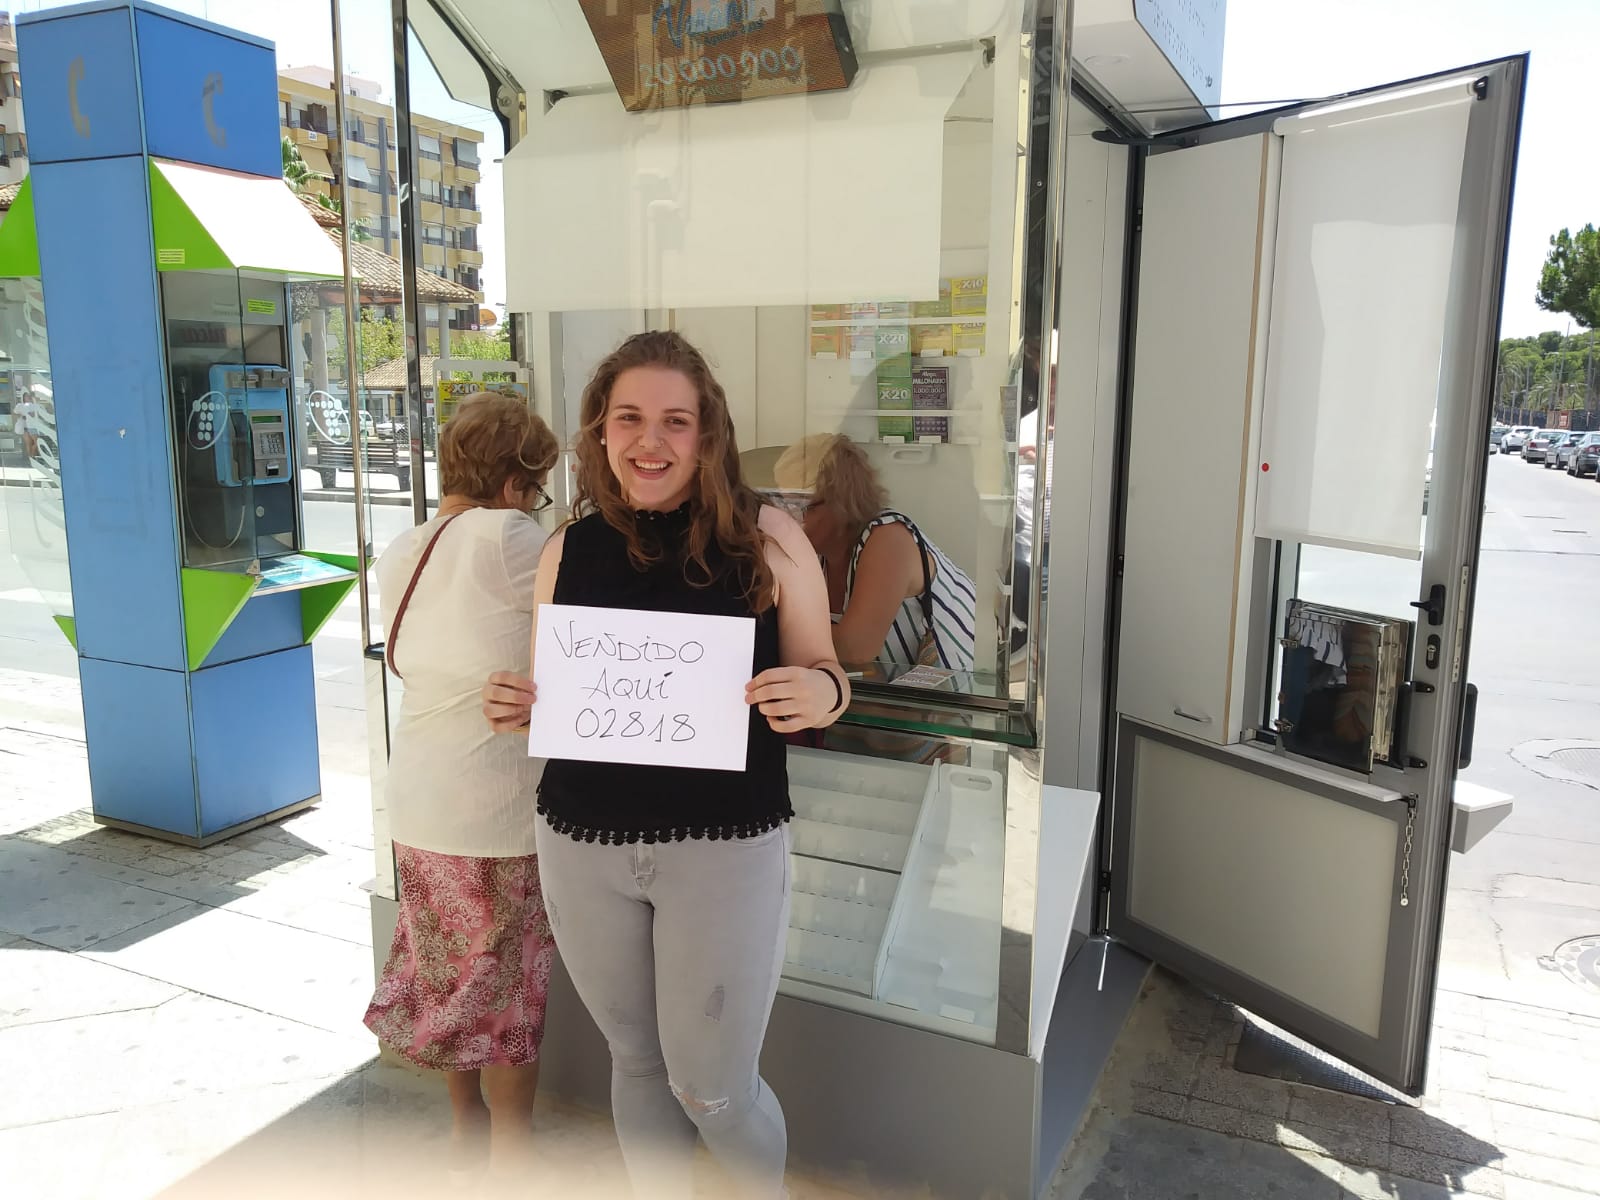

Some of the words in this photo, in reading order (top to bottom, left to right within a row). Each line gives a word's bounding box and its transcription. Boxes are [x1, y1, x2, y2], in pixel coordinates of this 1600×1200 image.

[878, 333, 906, 344] X20
[452, 384, 479, 394] X10
[880, 389, 909, 400] X20
[575, 708, 696, 742] 02818
